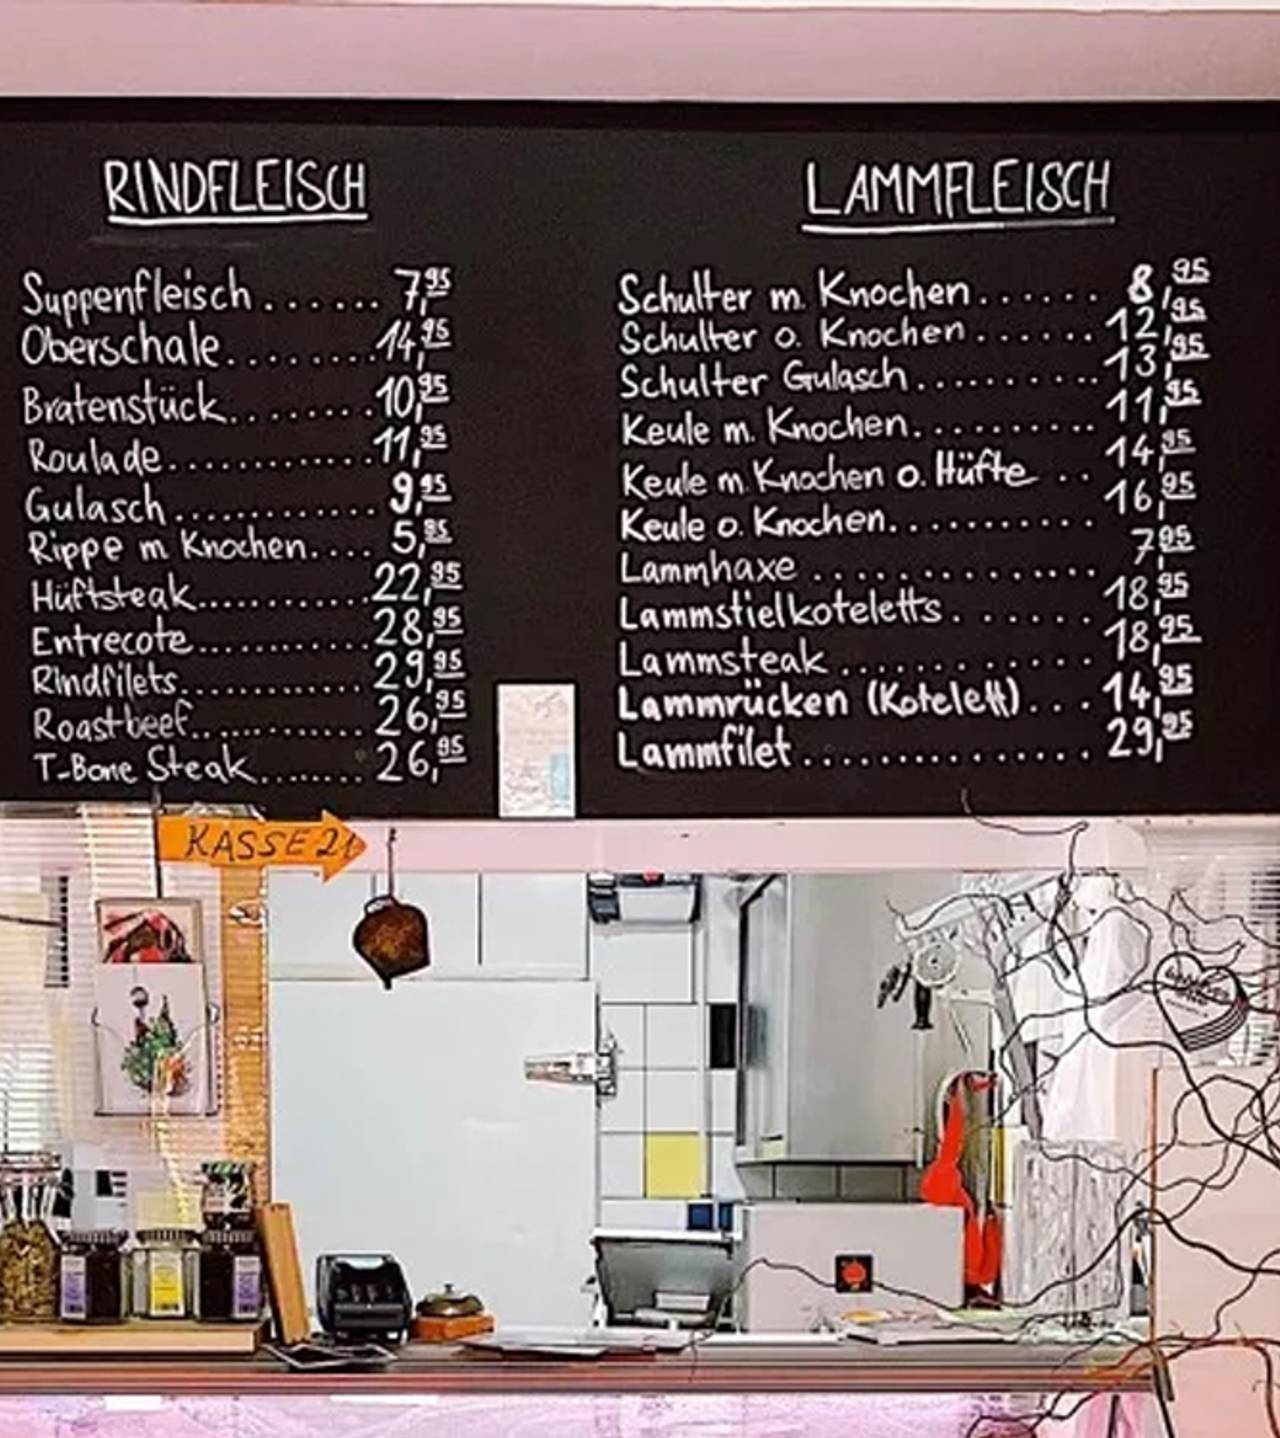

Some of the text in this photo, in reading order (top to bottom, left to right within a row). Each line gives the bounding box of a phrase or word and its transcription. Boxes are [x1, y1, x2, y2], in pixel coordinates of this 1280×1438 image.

[104, 158, 365, 214] RINDFLEISCH
[807, 158, 1110, 219] LAMMFLEISCH
[23, 266, 251, 329] Suppenfleisch
[618, 269, 752, 315] Schulter
[818, 267, 970, 310] Knochen
[21, 319, 219, 367] Oberschale
[619, 318, 758, 355] Schulter
[820, 315, 964, 348] Knochen
[620, 361, 768, 399] Schulter
[783, 356, 907, 393] Gulasch
[23, 378, 227, 425] Bratenstück
[623, 410, 710, 446] Keule
[767, 405, 908, 444] Knochen
[29, 437, 162, 476] Roulade
[623, 461, 707, 500] Keule
[753, 453, 884, 493] Knochen
[936, 448, 1038, 487] Hüfte
[25, 482, 166, 525] Gulasch
[621, 505, 705, 542] Keule
[753, 503, 885, 537] Knochen
[28, 530, 123, 571] Rippe
[180, 525, 306, 560] Knochen
[621, 549, 797, 587] Lammhaxe
[32, 572, 197, 613] Hüftsteak
[620, 586, 942, 630] Lammstielkoteletts
[32, 614, 194, 657] Entrecote
[619, 635, 828, 677] Lammsteak
[34, 699, 193, 742] Roastbeef
[618, 677, 848, 722] Lammrücken
[34, 752, 137, 784] T-Bone
[147, 743, 257, 783] Steak
[618, 723, 791, 770] Lammfilet
[184, 825, 310, 862] KASSE
